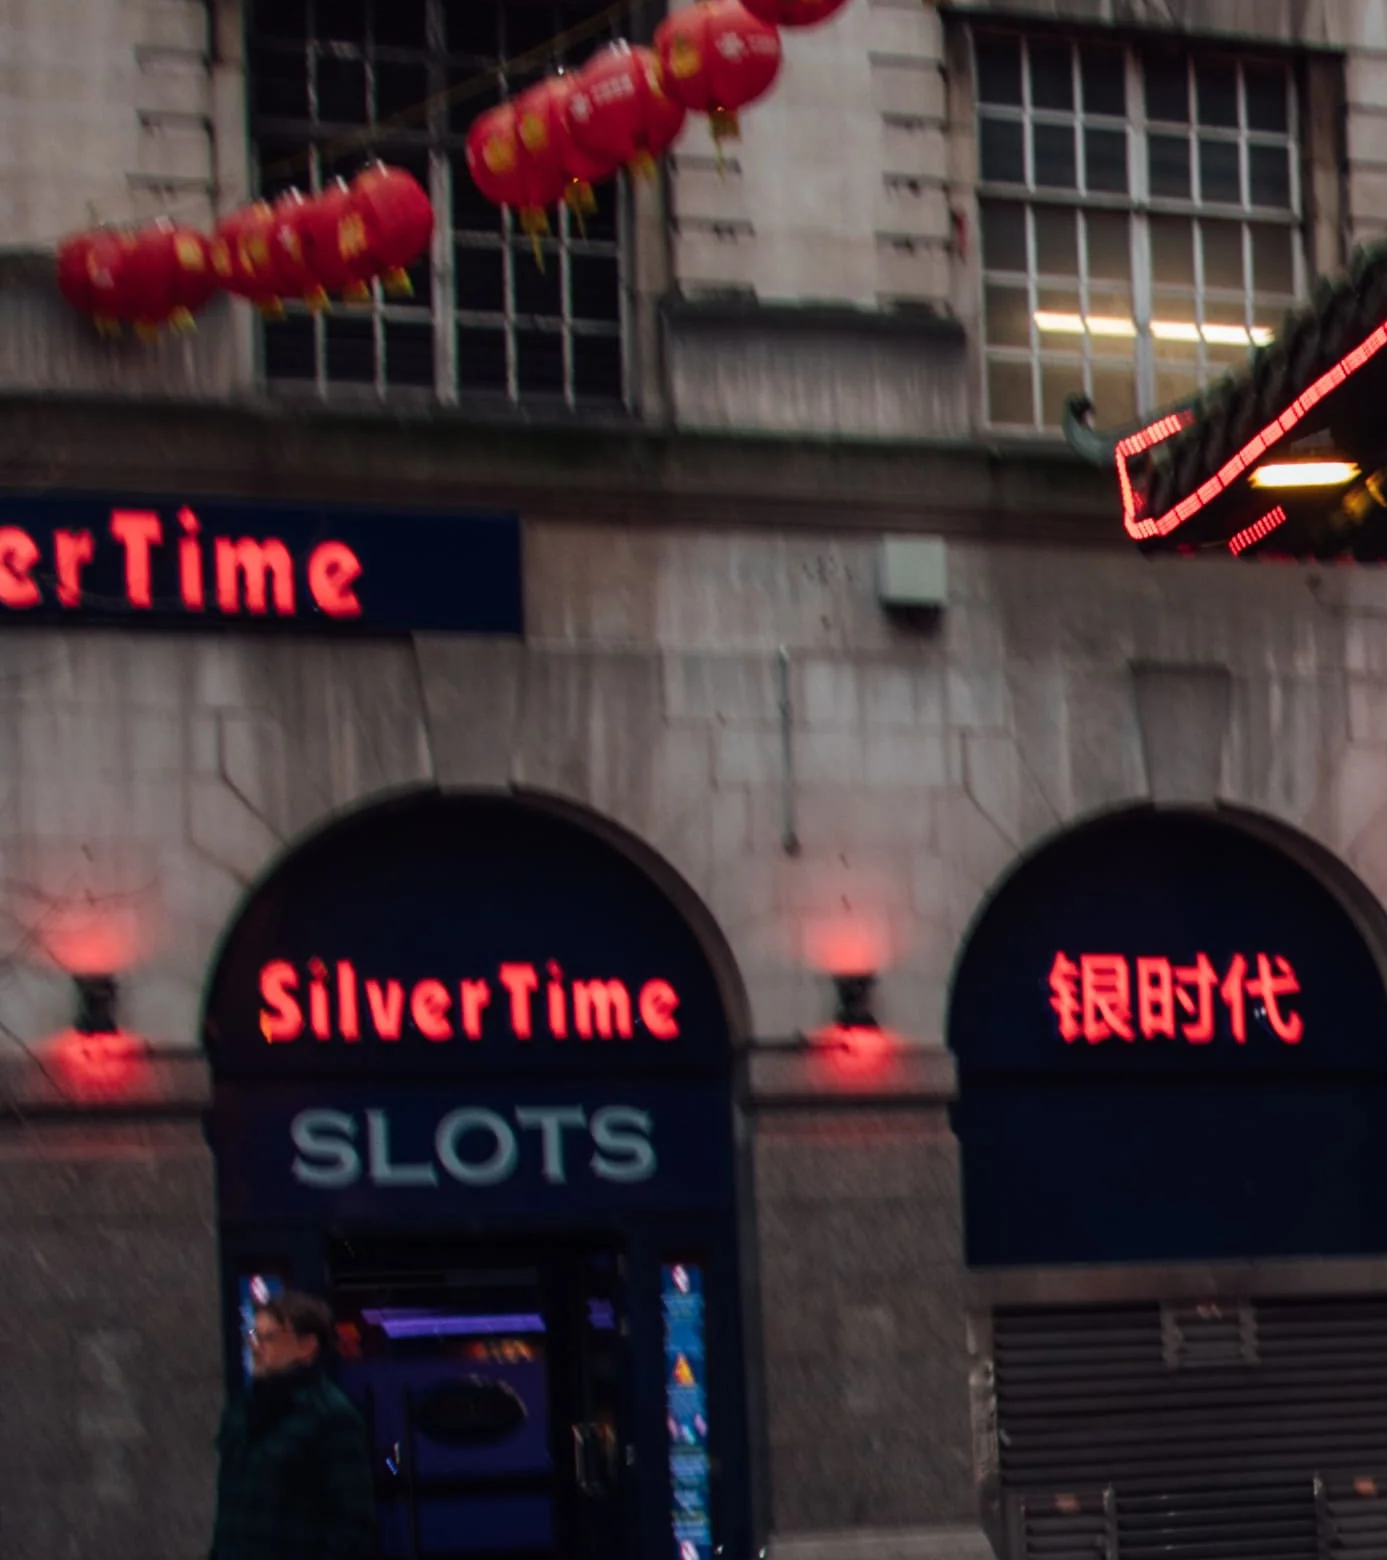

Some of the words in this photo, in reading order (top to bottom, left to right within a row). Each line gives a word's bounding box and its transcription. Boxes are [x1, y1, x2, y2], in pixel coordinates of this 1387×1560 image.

[258, 957, 681, 1044] SilverTime
[1048, 950, 1303, 1045] 银时代
[291, 1105, 657, 1187] SLOTS
